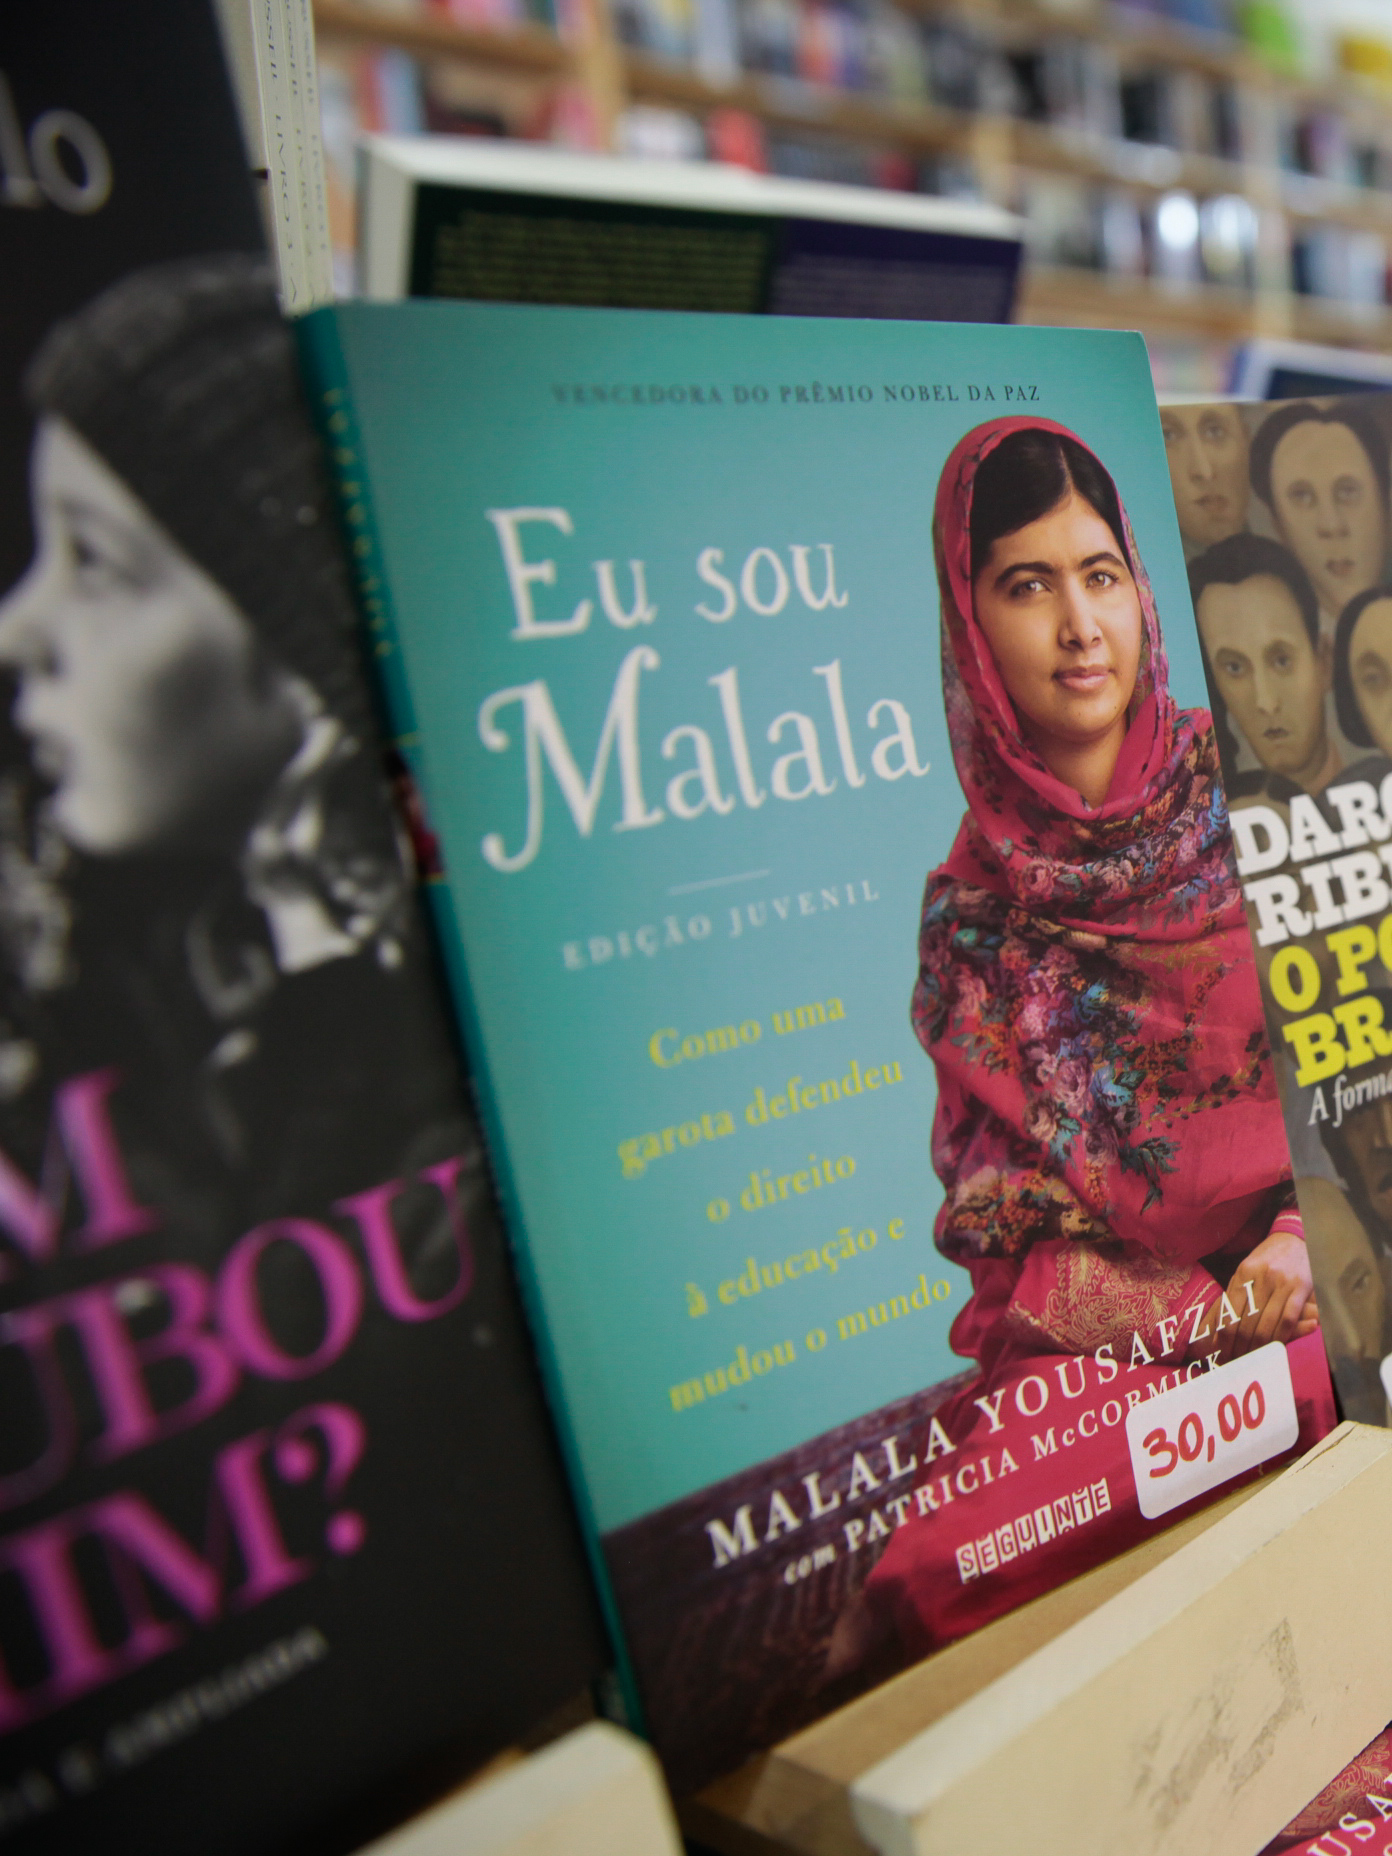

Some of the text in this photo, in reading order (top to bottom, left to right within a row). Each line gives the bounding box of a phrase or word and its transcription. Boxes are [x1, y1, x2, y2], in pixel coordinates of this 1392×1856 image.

[551, 380, 1040, 403] VENCEDORA DO PRÊMIO NOBEL DA PAZ
[484, 505, 850, 642] Eu sou
[476, 645, 932, 873] Malala
[562, 879, 881, 972] EDIÇÃO JUVENIL
[1268, 944, 1322, 1013] O
[648, 995, 847, 1069] Como uma
[616, 1057, 906, 1181] garota defendeu
[1307, 1085, 1330, 1127] A
[705, 1152, 858, 1225] o direito
[685, 1214, 907, 1320] à educação e
[667, 1272, 953, 1414] mudou o mundo
[703, 1279, 1262, 1569] MALALA YOUSAFZAI
[783, 1349, 1223, 1586] com PATRICIA McCORMICK
[1142, 1379, 1267, 1479] 30,00
[955, 1477, 1113, 1585] SEGUINTE
